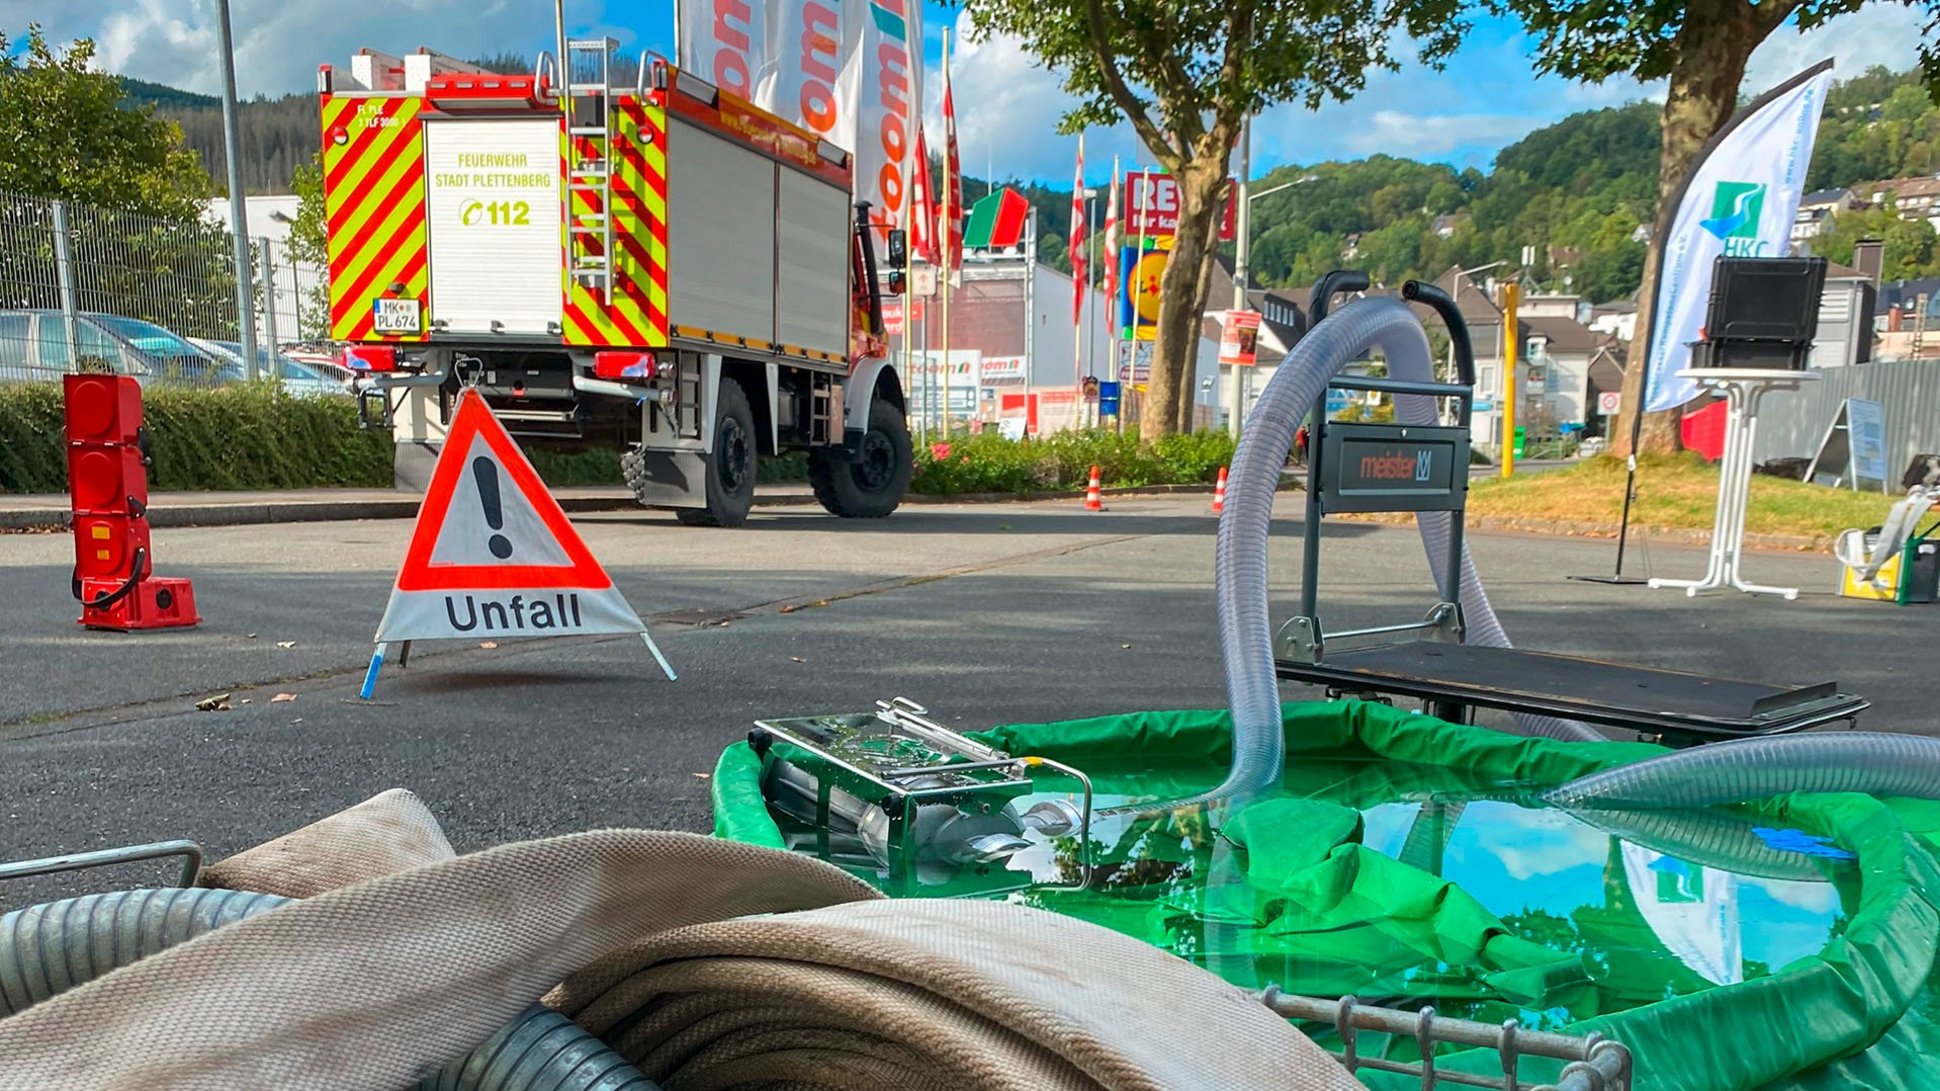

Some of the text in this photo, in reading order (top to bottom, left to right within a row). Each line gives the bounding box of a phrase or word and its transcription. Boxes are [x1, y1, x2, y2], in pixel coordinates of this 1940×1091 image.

[458, 154, 528, 168] FEUERWEHR
[435, 174, 551, 188] STADT PLETTENBERG
[487, 201, 530, 225] 112
[384, 302, 399, 314] MK
[378, 315, 416, 328] PL 674
[1360, 451, 1416, 479] meister
[445, 593, 582, 632] Unfall
